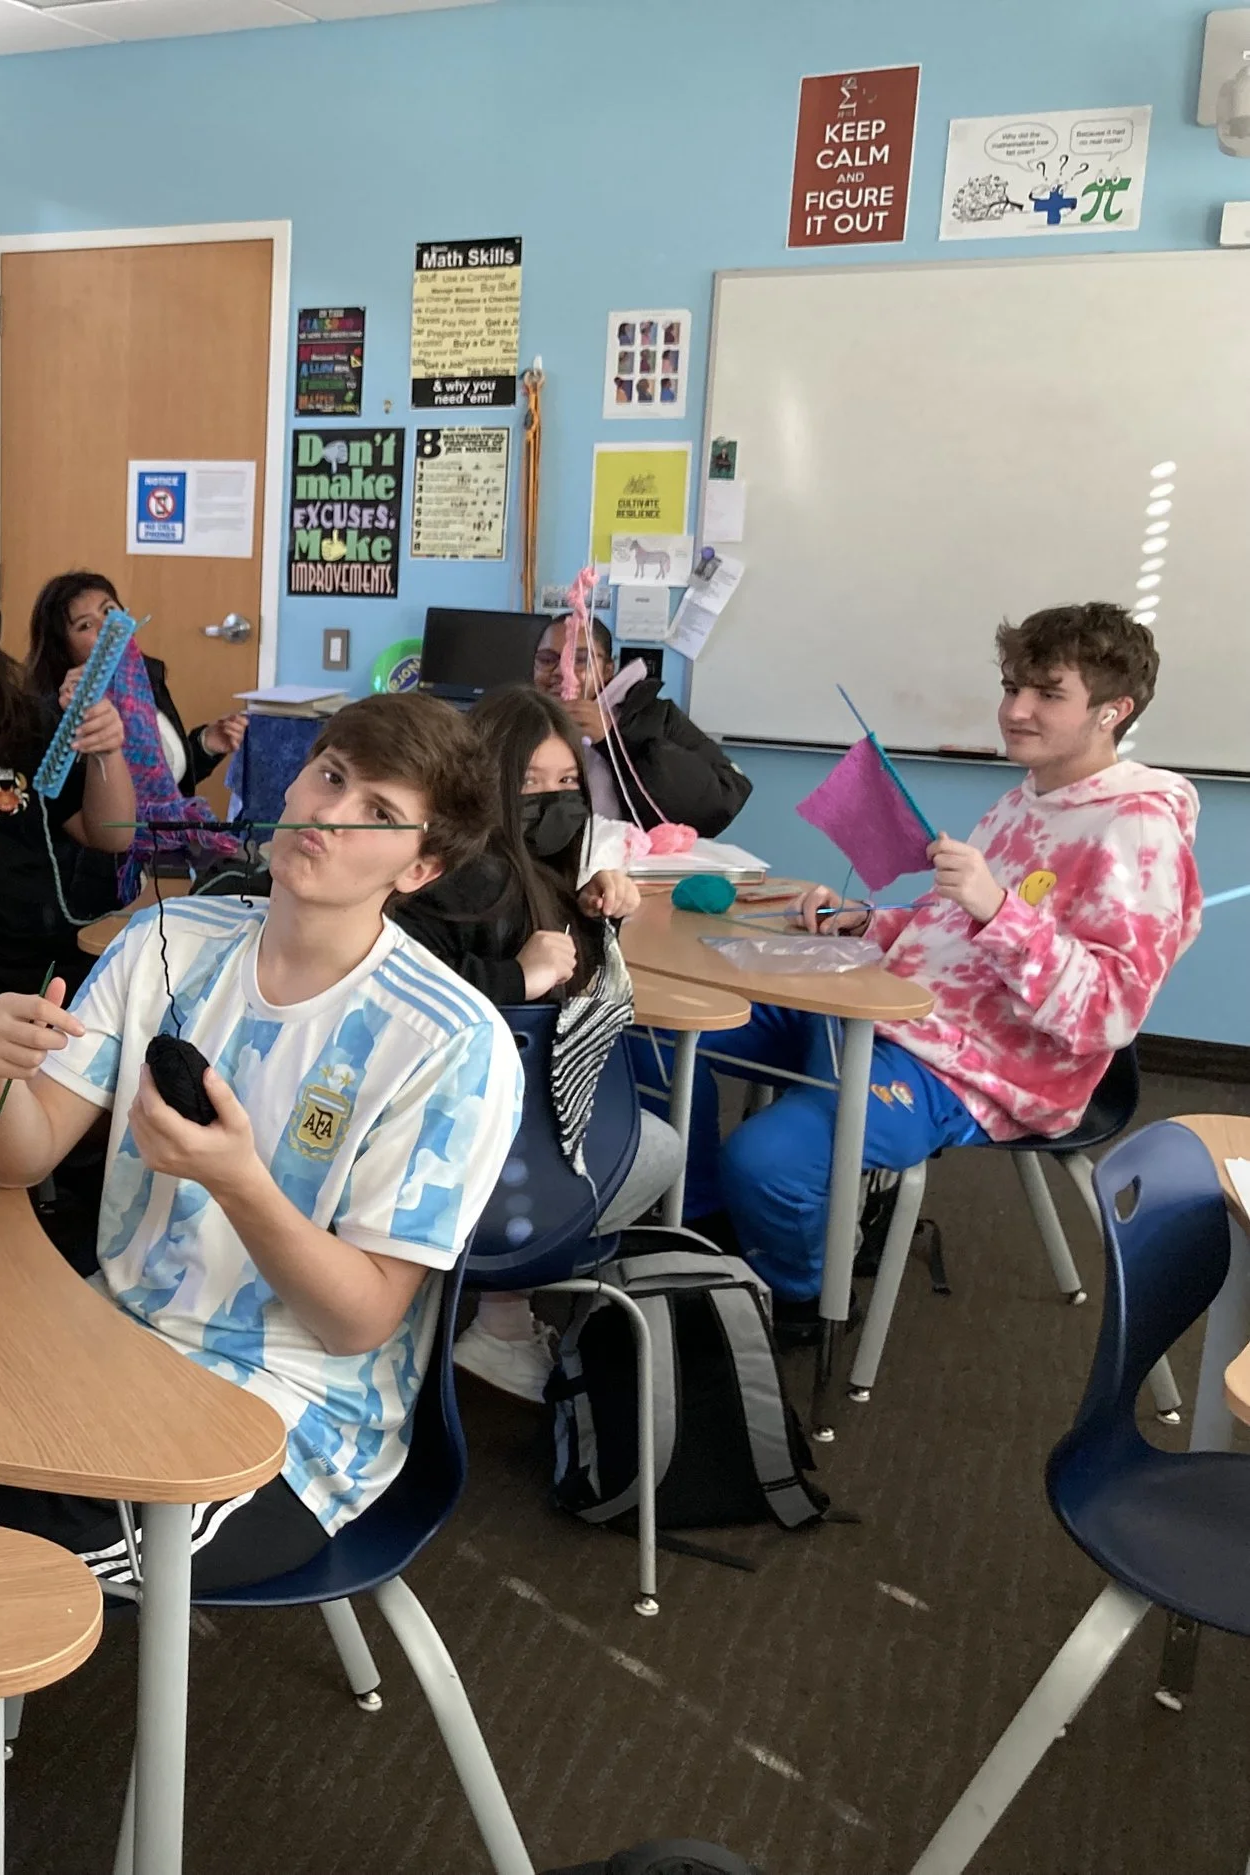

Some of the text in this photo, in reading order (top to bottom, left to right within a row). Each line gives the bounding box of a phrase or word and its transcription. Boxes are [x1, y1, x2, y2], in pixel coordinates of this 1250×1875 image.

[825, 119, 886, 144] KEEP
[816, 144, 890, 169] CALM
[837, 172, 865, 184] AND
[805, 186, 894, 211] FIGURE
[806, 211, 889, 235] IT OUT
[422, 247, 514, 268] Math Skills
[453, 340, 470, 349] Buy
[480, 338, 496, 347] Car
[433, 380, 496, 394] & why you
[434, 393, 464, 405] need
[416, 429, 441, 459] 8
[443, 433, 504, 441] MATHEMATICAL
[296, 468, 396, 501] make
[616, 510, 661, 519] RESILIENCE
[618, 499, 660, 509] CULTIVATE
[291, 562, 395, 594] IMPROVEMENTS.
[303, 1106, 334, 1140] AFA
